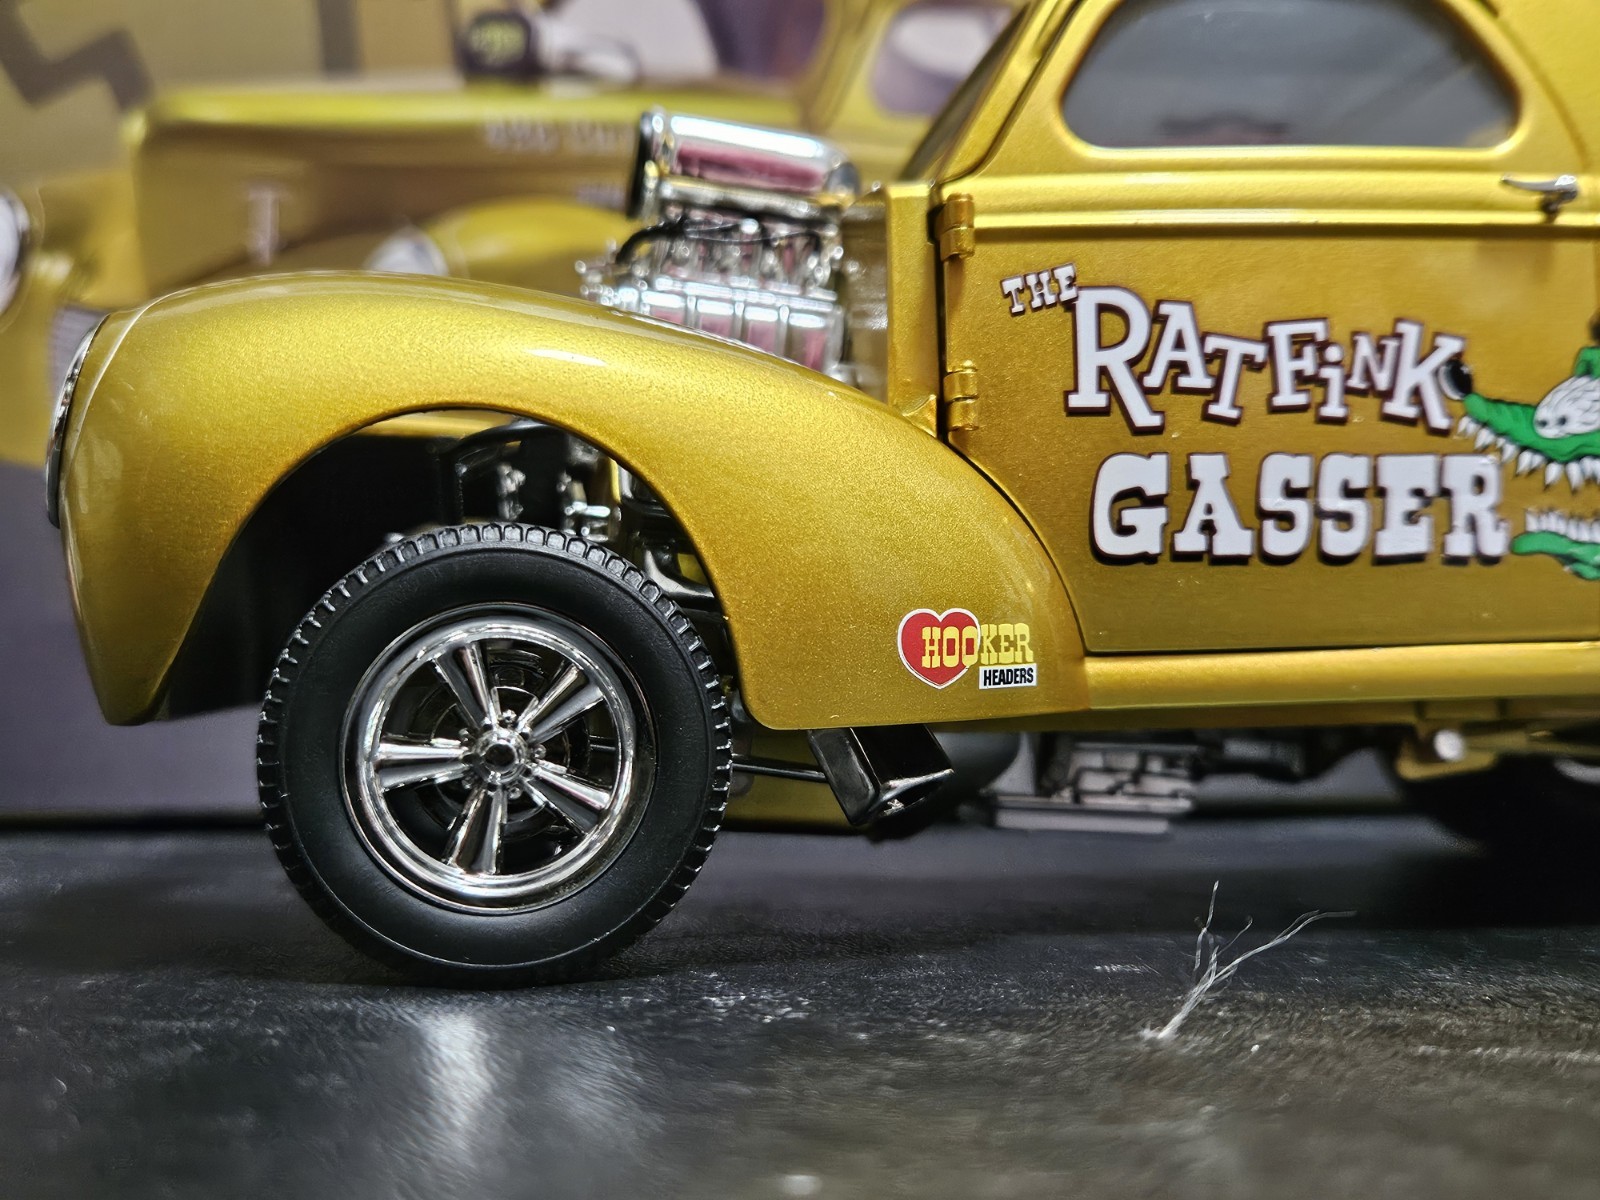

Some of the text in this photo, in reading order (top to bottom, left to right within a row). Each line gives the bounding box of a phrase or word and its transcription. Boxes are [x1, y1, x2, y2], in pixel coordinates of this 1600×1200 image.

[1000, 263, 1078, 315] THE
[1091, 452, 1509, 564] GASSER
[922, 623, 1034, 668] HOOKER
[983, 667, 1034, 686] HEADERS
